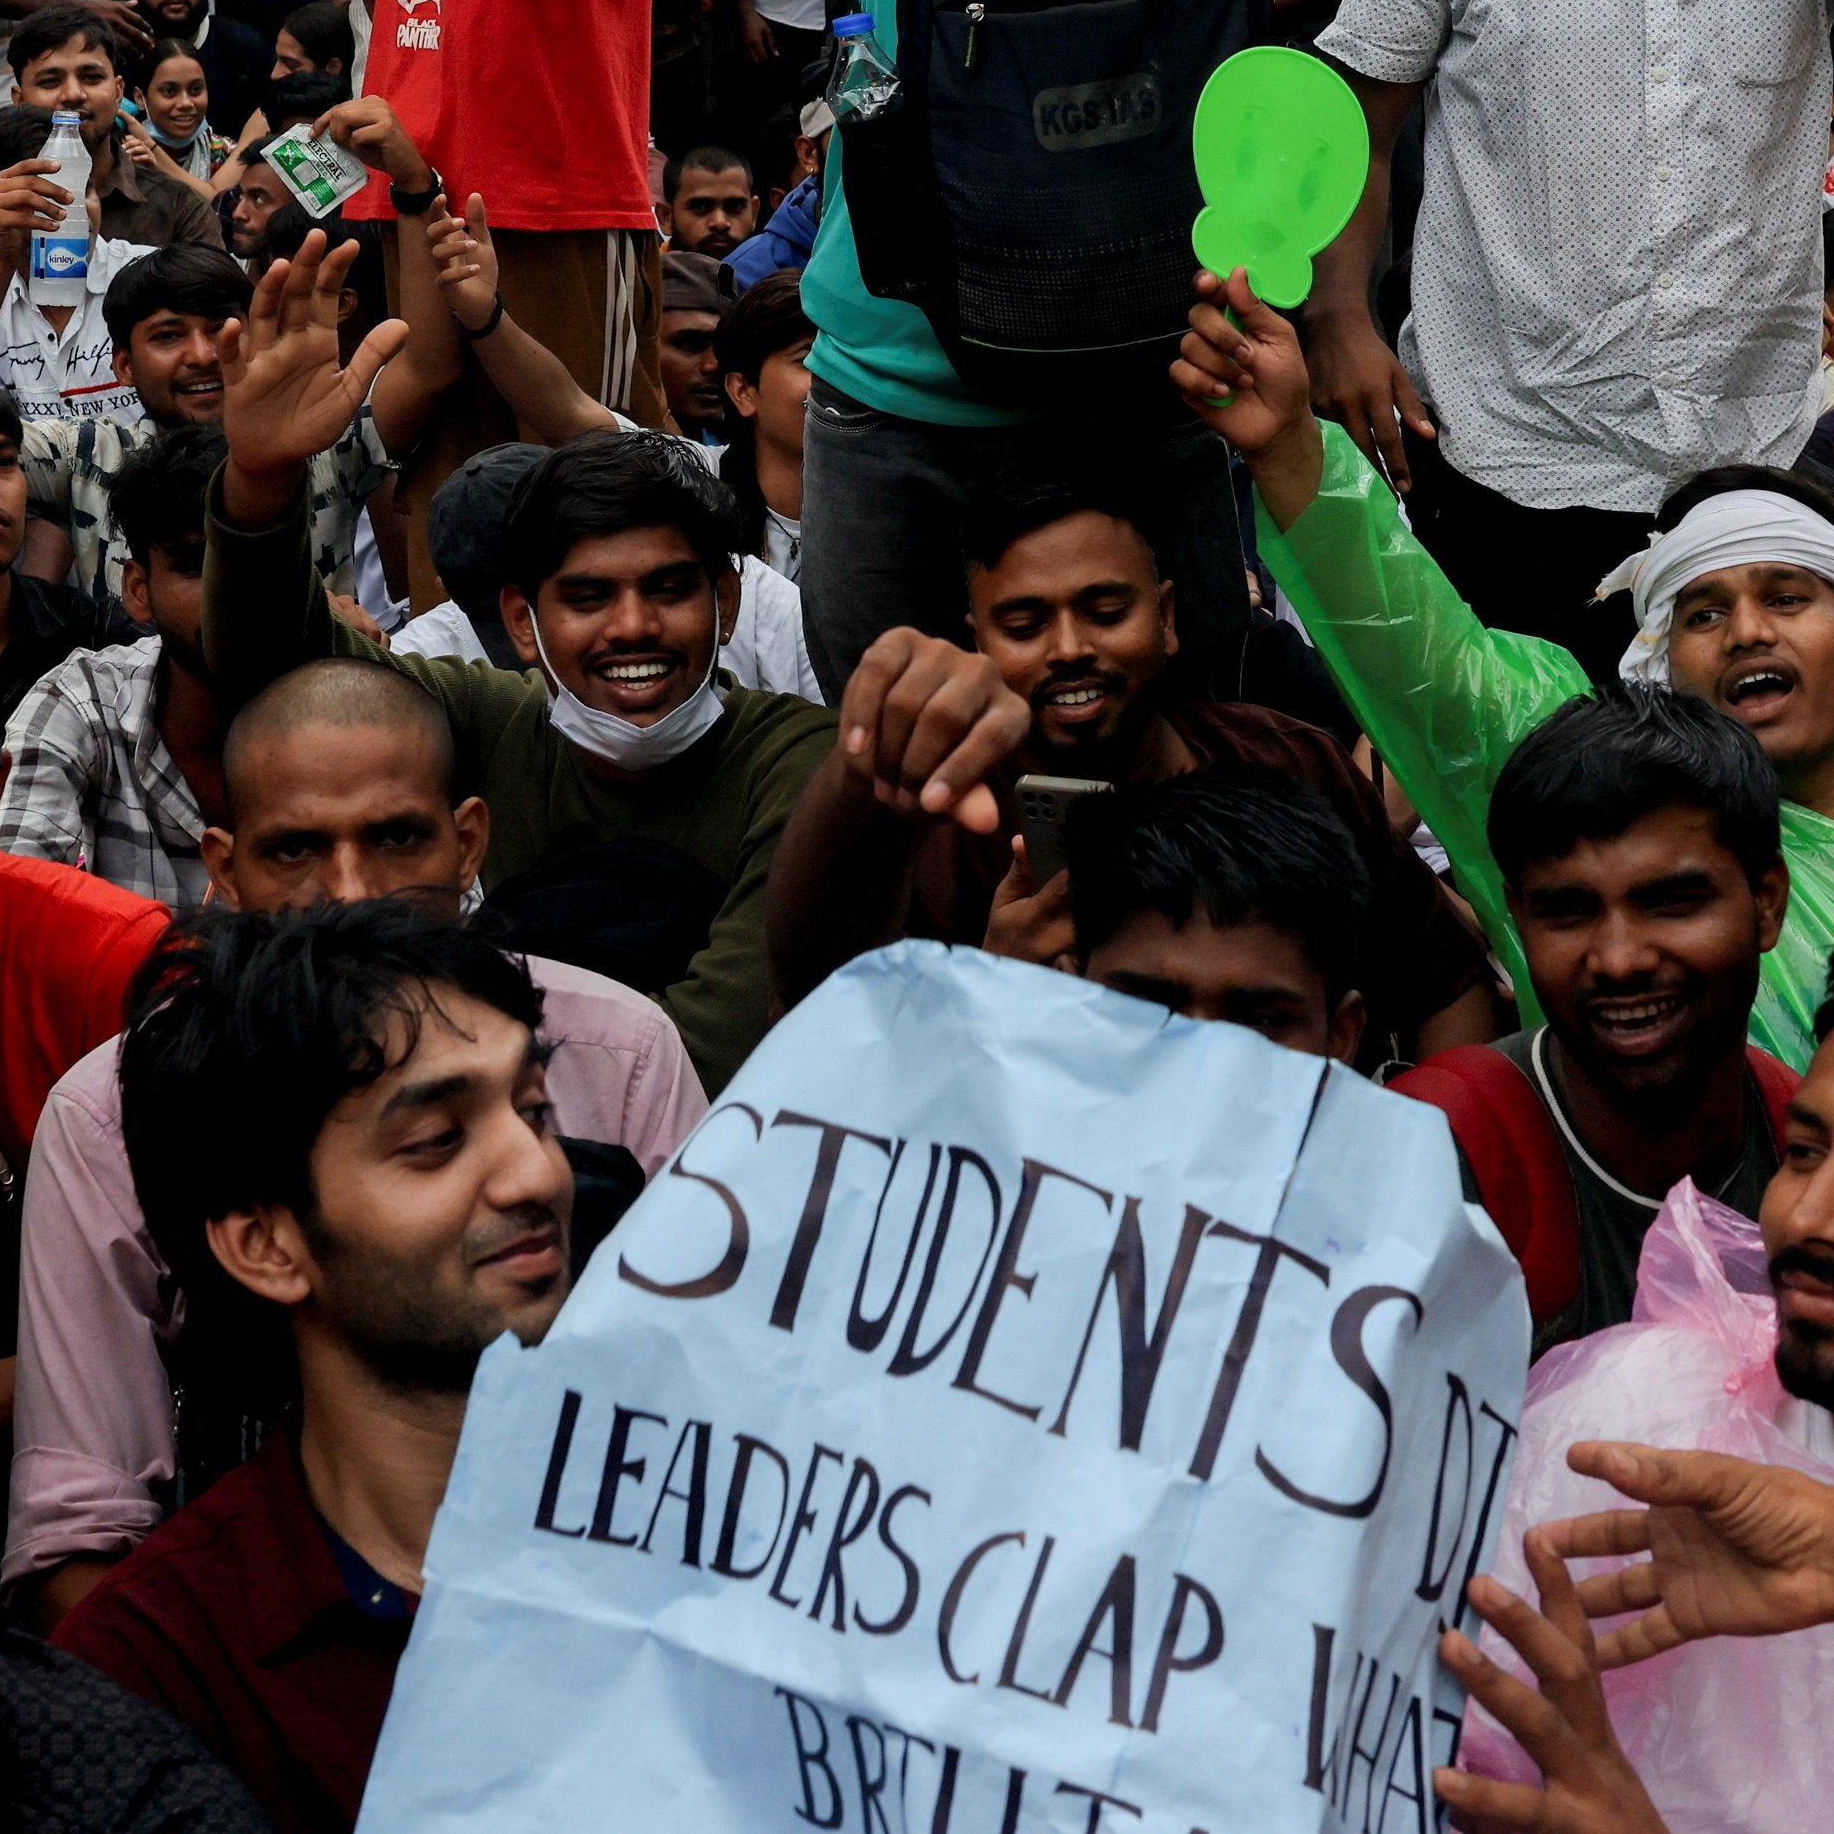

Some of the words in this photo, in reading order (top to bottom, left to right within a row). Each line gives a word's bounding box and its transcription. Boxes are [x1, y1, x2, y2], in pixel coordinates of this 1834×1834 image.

[1039, 99, 1100, 136] KGS
[306, 138, 345, 181] ELECTRAL
[48, 253, 75, 265] kinley
[69, 397, 105, 417] NEW
[108, 391, 141, 411] YOR
[616, 1100, 1422, 1520] STUDENTS
[532, 1388, 932, 1638] LEADERS
[936, 1529, 1225, 1733] CLAP
